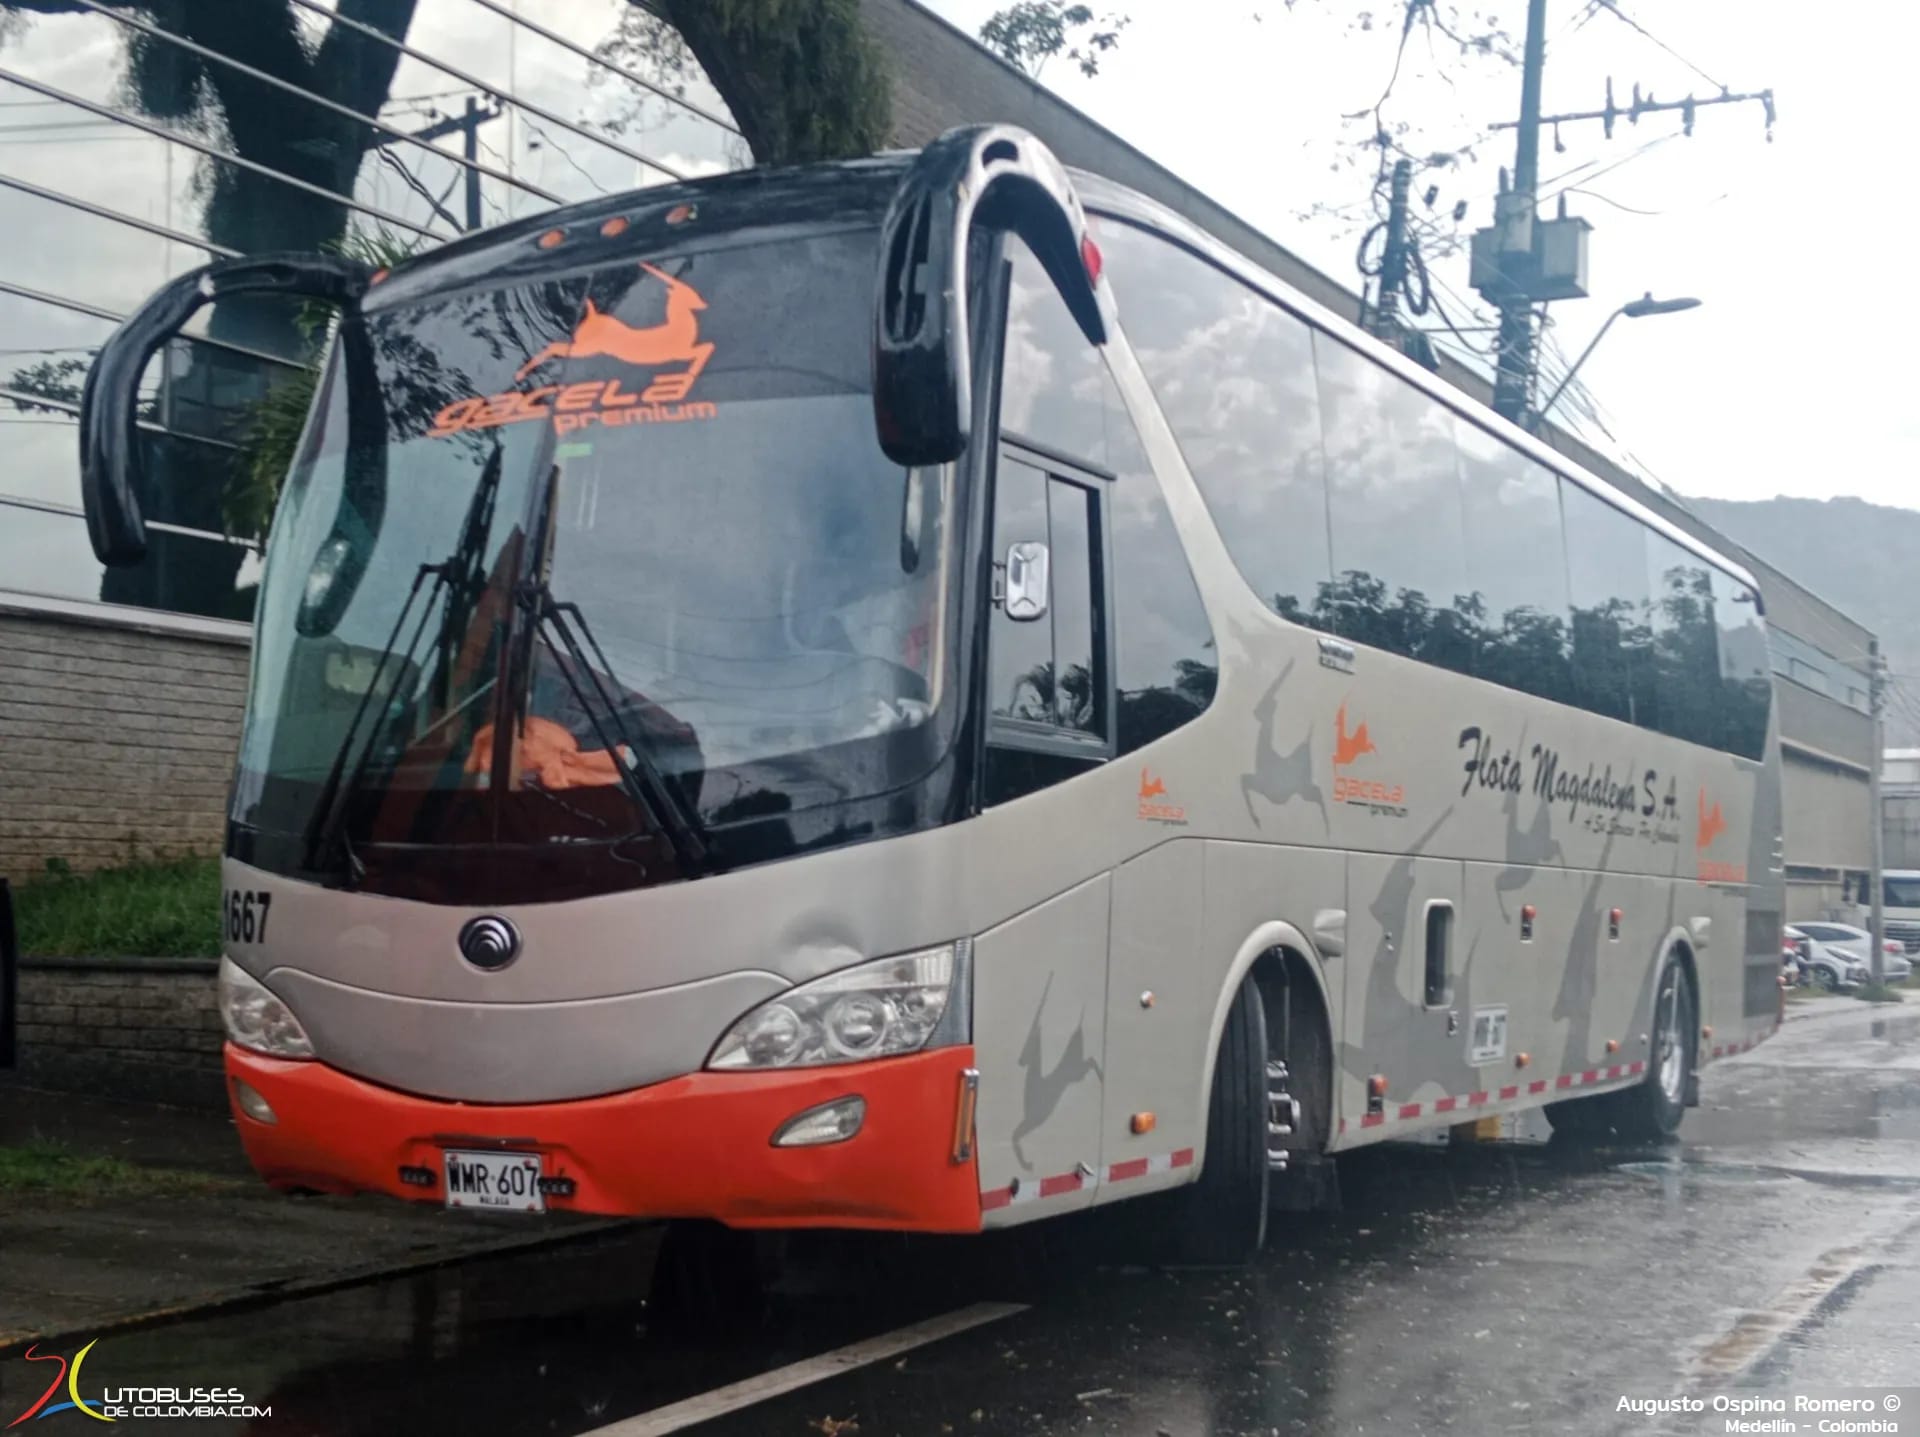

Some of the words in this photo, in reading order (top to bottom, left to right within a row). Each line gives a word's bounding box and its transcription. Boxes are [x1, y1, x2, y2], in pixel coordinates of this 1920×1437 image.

[553, 402, 718, 436] premium
[1458, 727, 1522, 797] Flota
[1532, 743, 1636, 823] Magdalena
